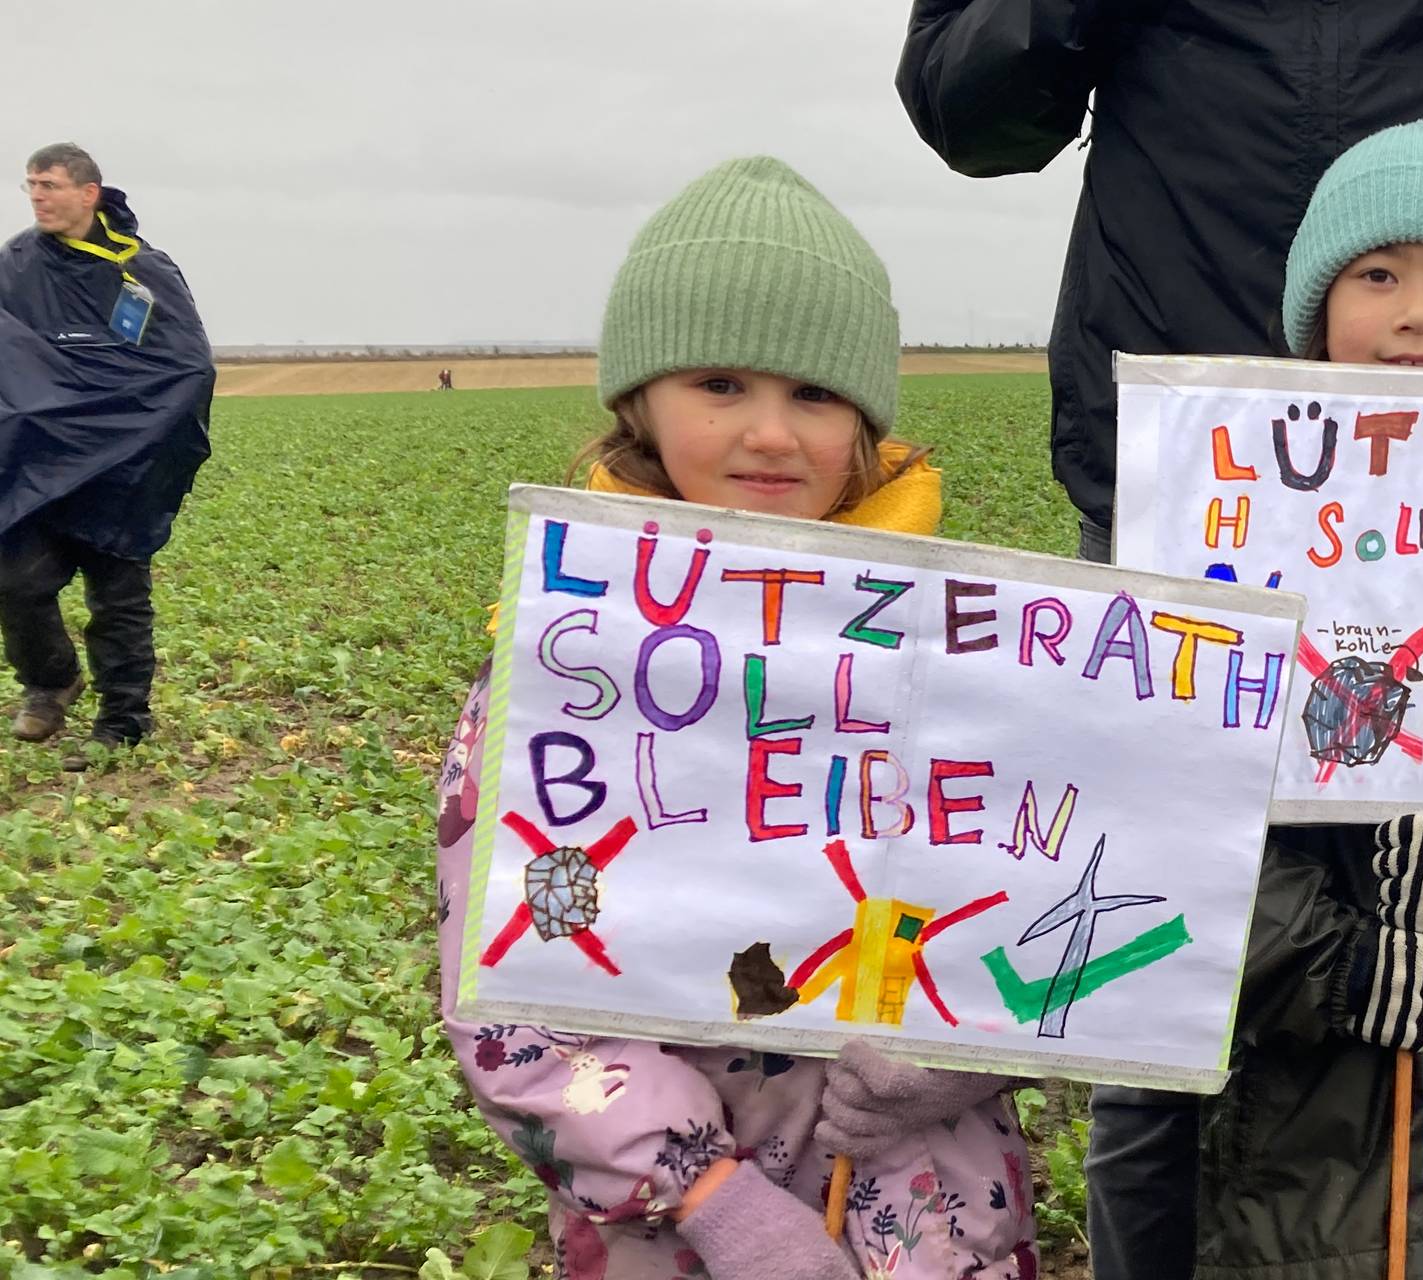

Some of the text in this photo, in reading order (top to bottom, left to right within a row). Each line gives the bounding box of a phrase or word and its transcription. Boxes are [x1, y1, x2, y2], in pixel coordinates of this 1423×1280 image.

[1204, 495, 1250, 549] H
[538, 608, 890, 735] SOLL
[542, 519, 1284, 730] LÜTZERATH
[528, 731, 1079, 862] BLEIBEN
